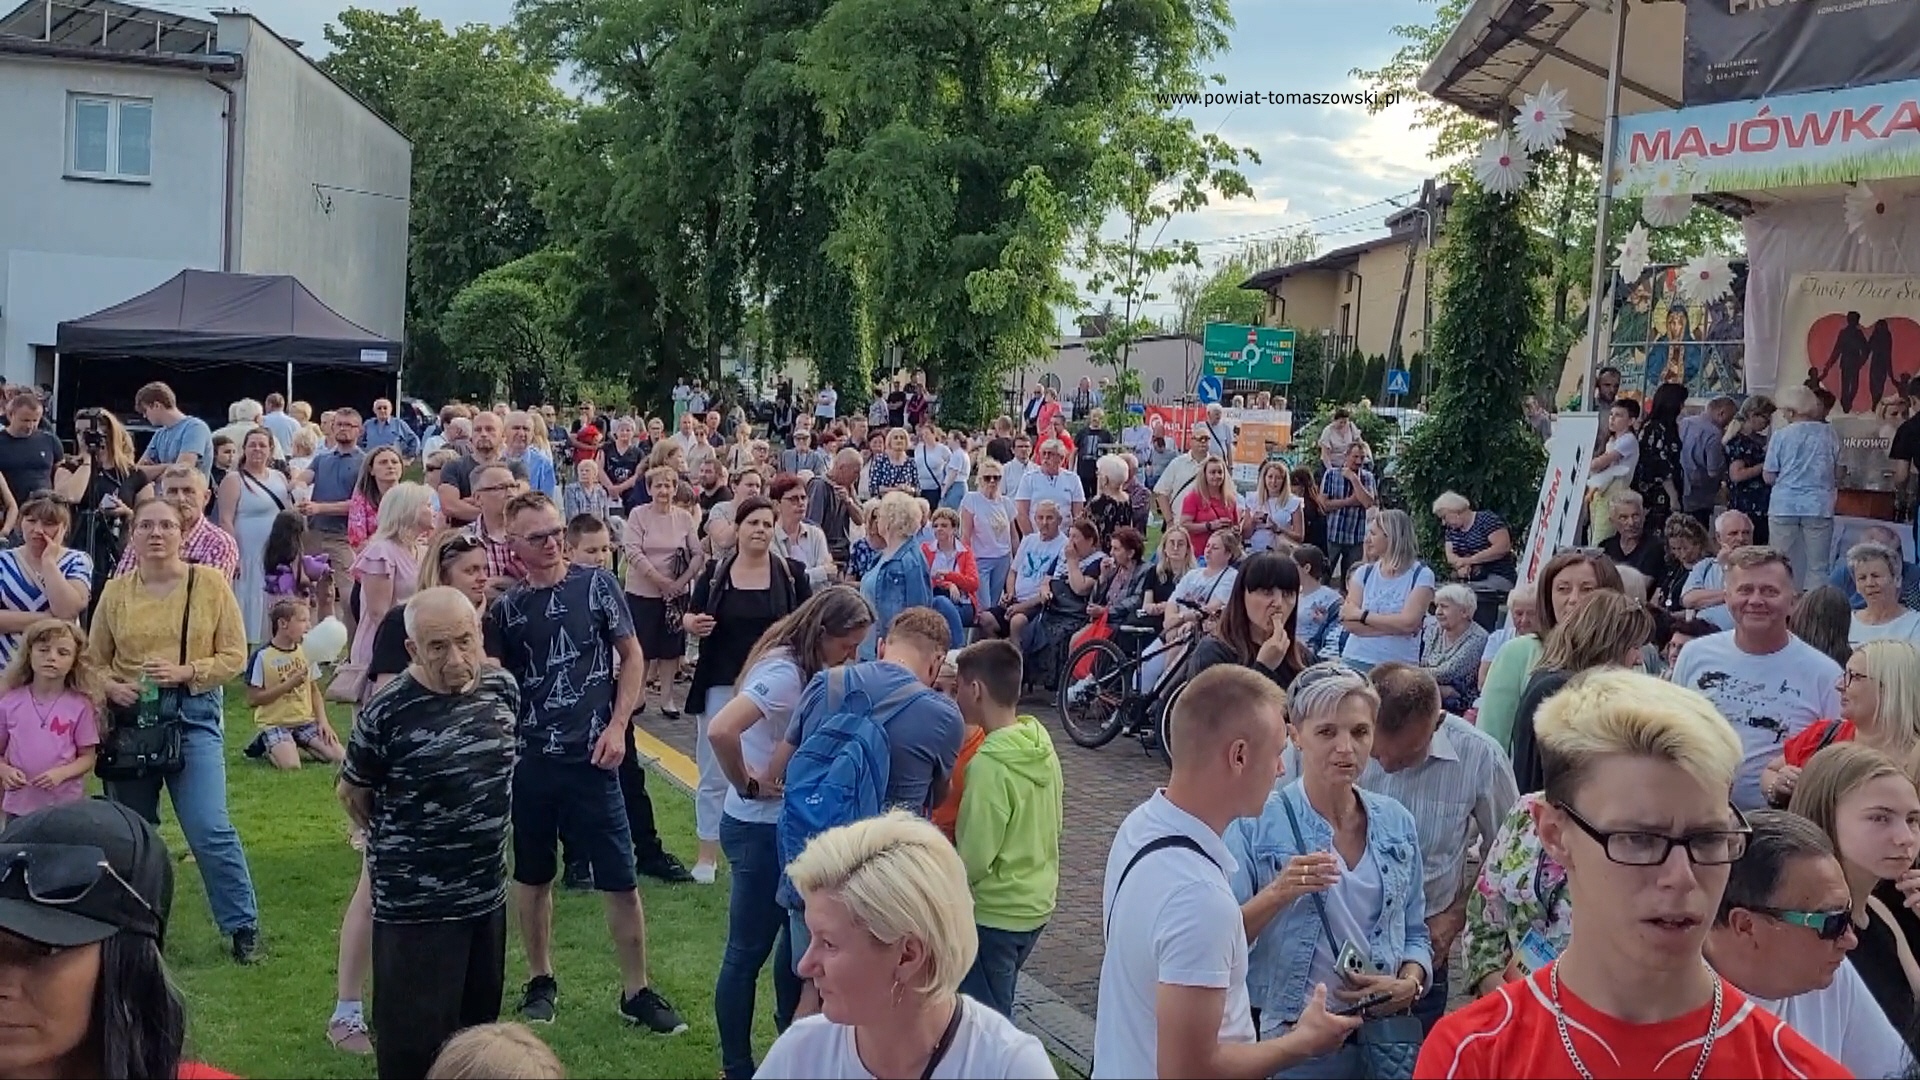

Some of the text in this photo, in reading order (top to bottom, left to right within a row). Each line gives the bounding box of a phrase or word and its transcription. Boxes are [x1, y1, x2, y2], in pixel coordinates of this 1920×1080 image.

[1629, 101, 1920, 164] MAJÓWKA
[1800, 277, 1920, 300] Twój Dar Se
